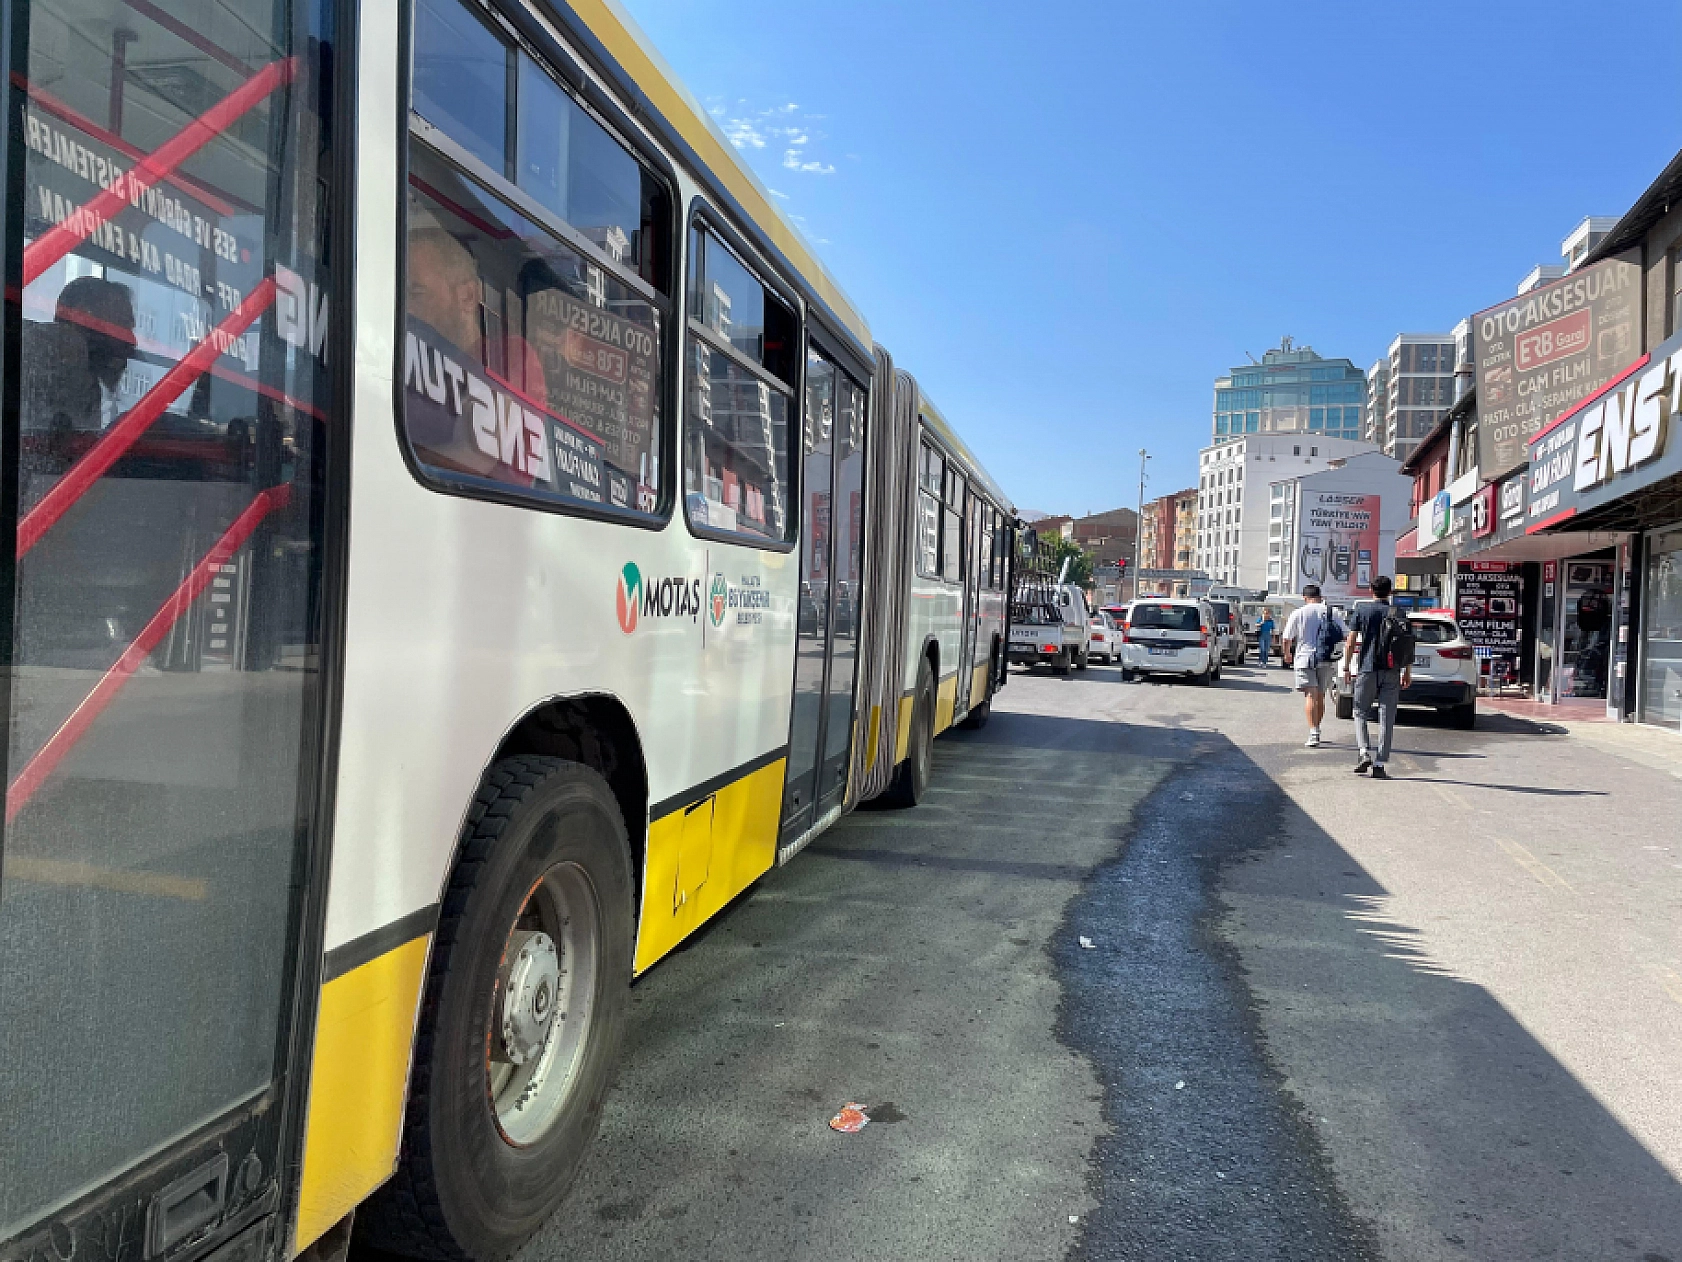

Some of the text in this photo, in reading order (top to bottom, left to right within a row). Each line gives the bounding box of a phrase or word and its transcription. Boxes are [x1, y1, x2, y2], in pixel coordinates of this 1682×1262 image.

[1481, 264, 1630, 341] OTO AKSESUAR
[1518, 372, 1549, 397] CAM
[1552, 354, 1591, 387] FİLMİ
[1493, 423, 1519, 442] OTO
[1521, 416, 1541, 435] SES
[1574, 361, 1667, 493] ENS
[643, 577, 701, 625] MOTAŞ
[1459, 619, 1484, 629] CAM
